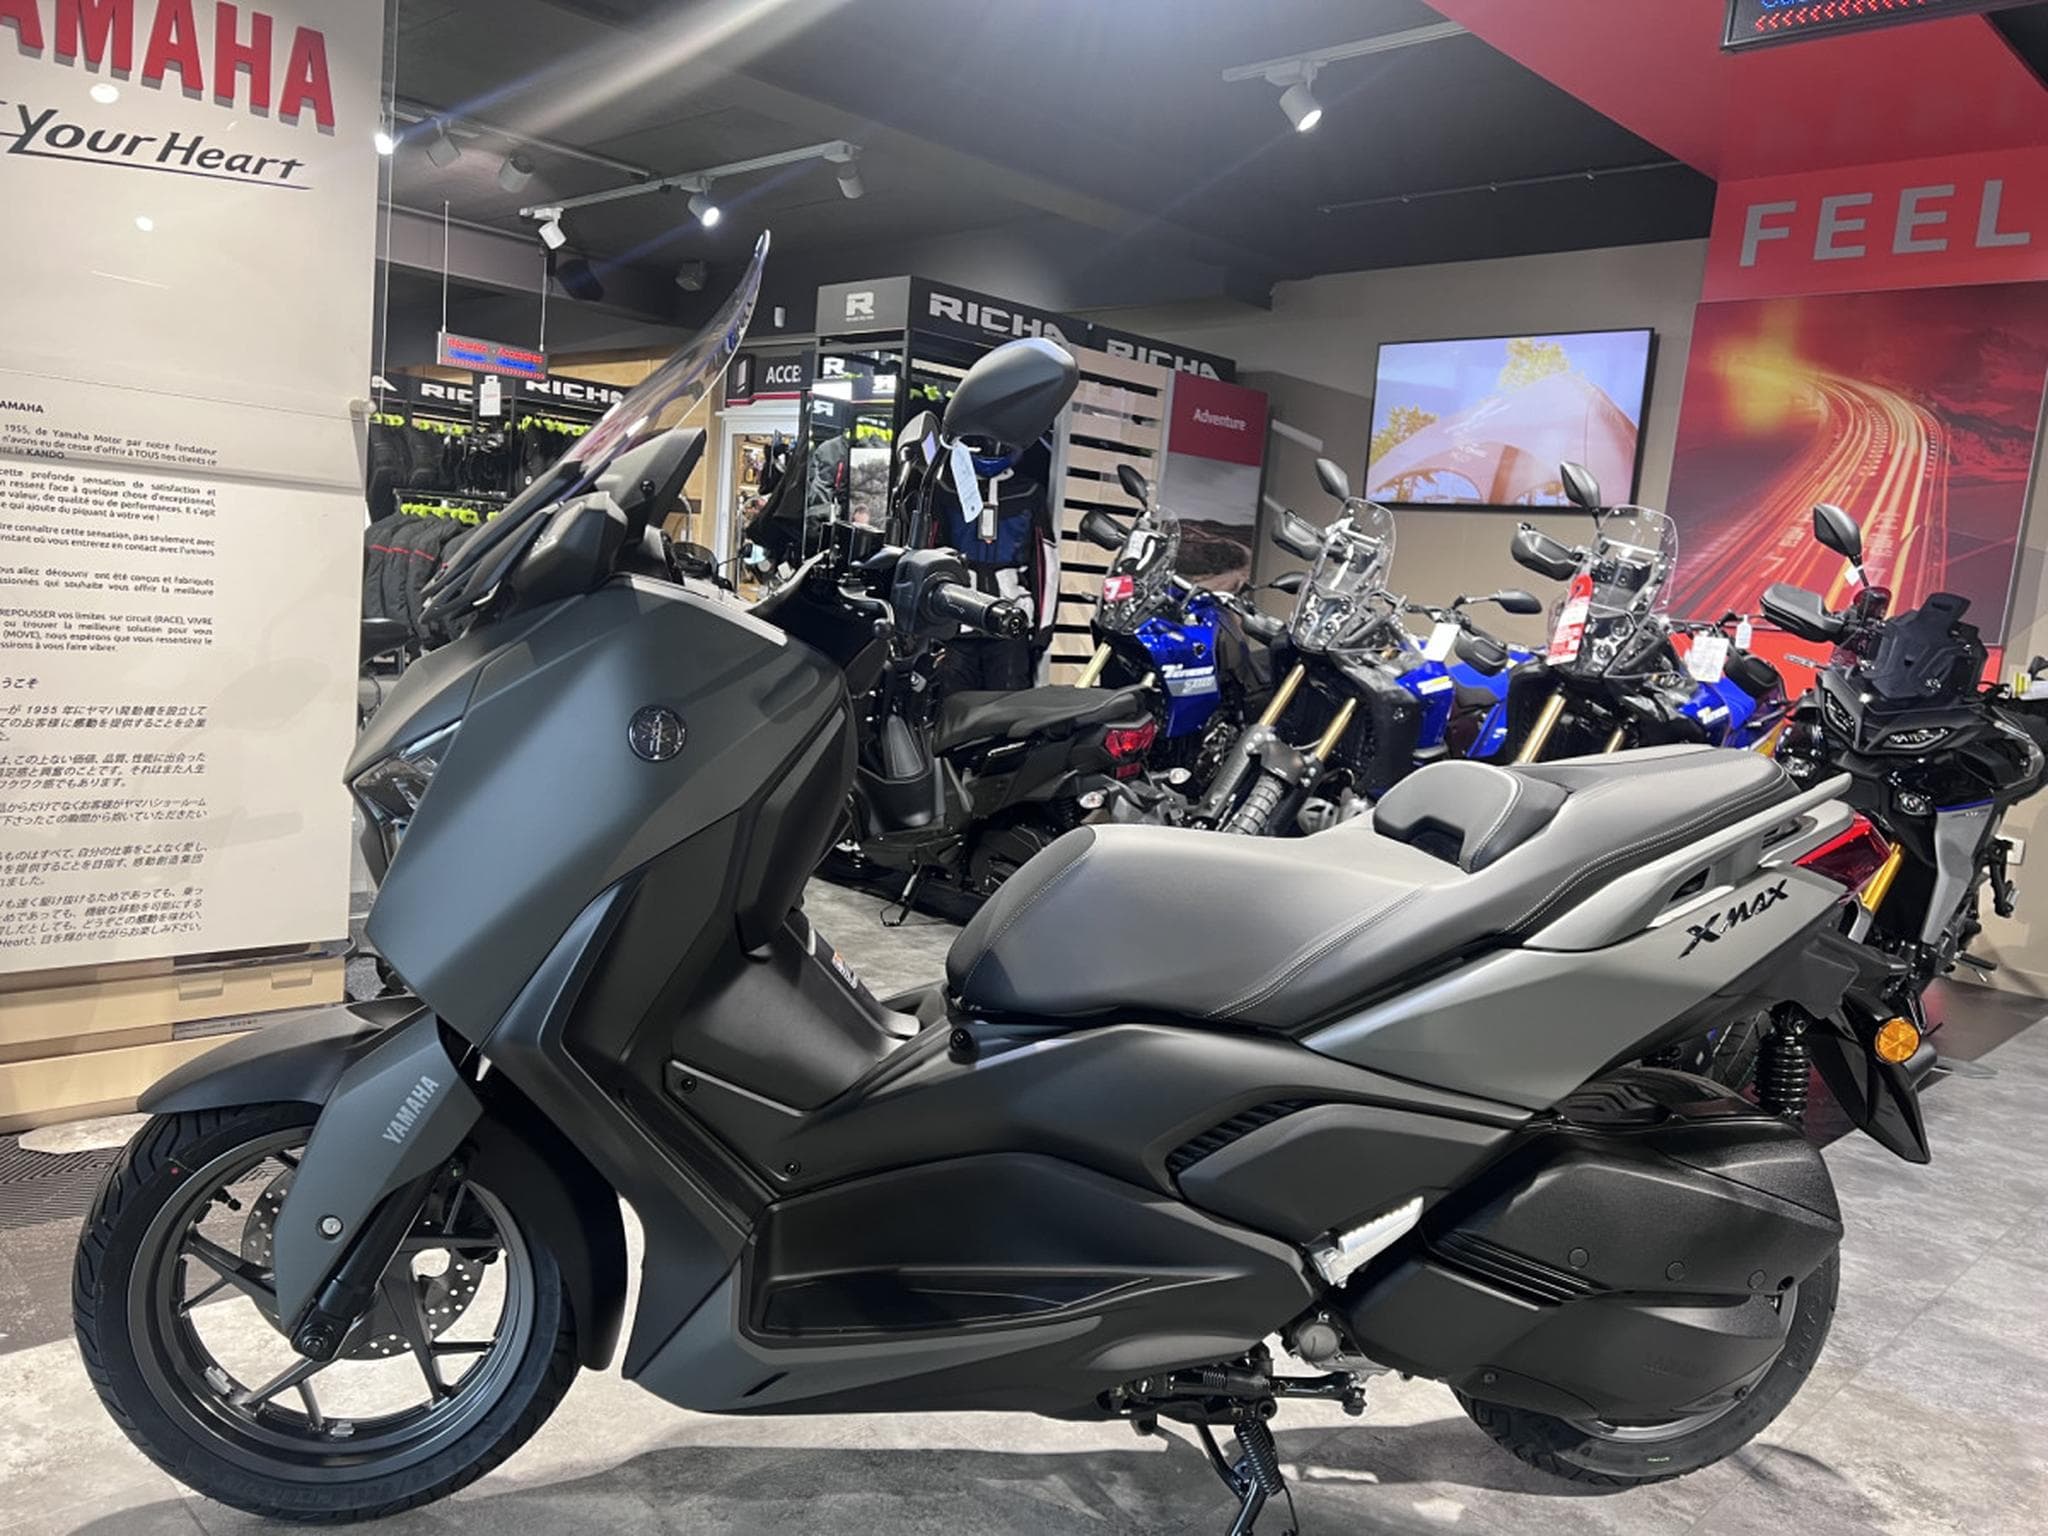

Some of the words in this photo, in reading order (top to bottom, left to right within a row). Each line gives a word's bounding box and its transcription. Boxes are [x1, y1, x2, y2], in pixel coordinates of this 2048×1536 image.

[7, 104, 157, 156] Your
[156, 131, 306, 180] Heart
[1739, 179, 2032, 267] FEEL
[845, 291, 875, 316] R
[928, 292, 1072, 346] RICHA
[1192, 408, 1248, 431] Adventure
[35, 427, 47, 436] de
[52, 429, 89, 441] Yamaha
[135, 449, 160, 460] TOUS
[9, 480, 45, 491] ressent
[31, 471, 75, 483] profonde
[381, 1075, 440, 1144] YAMAHA
